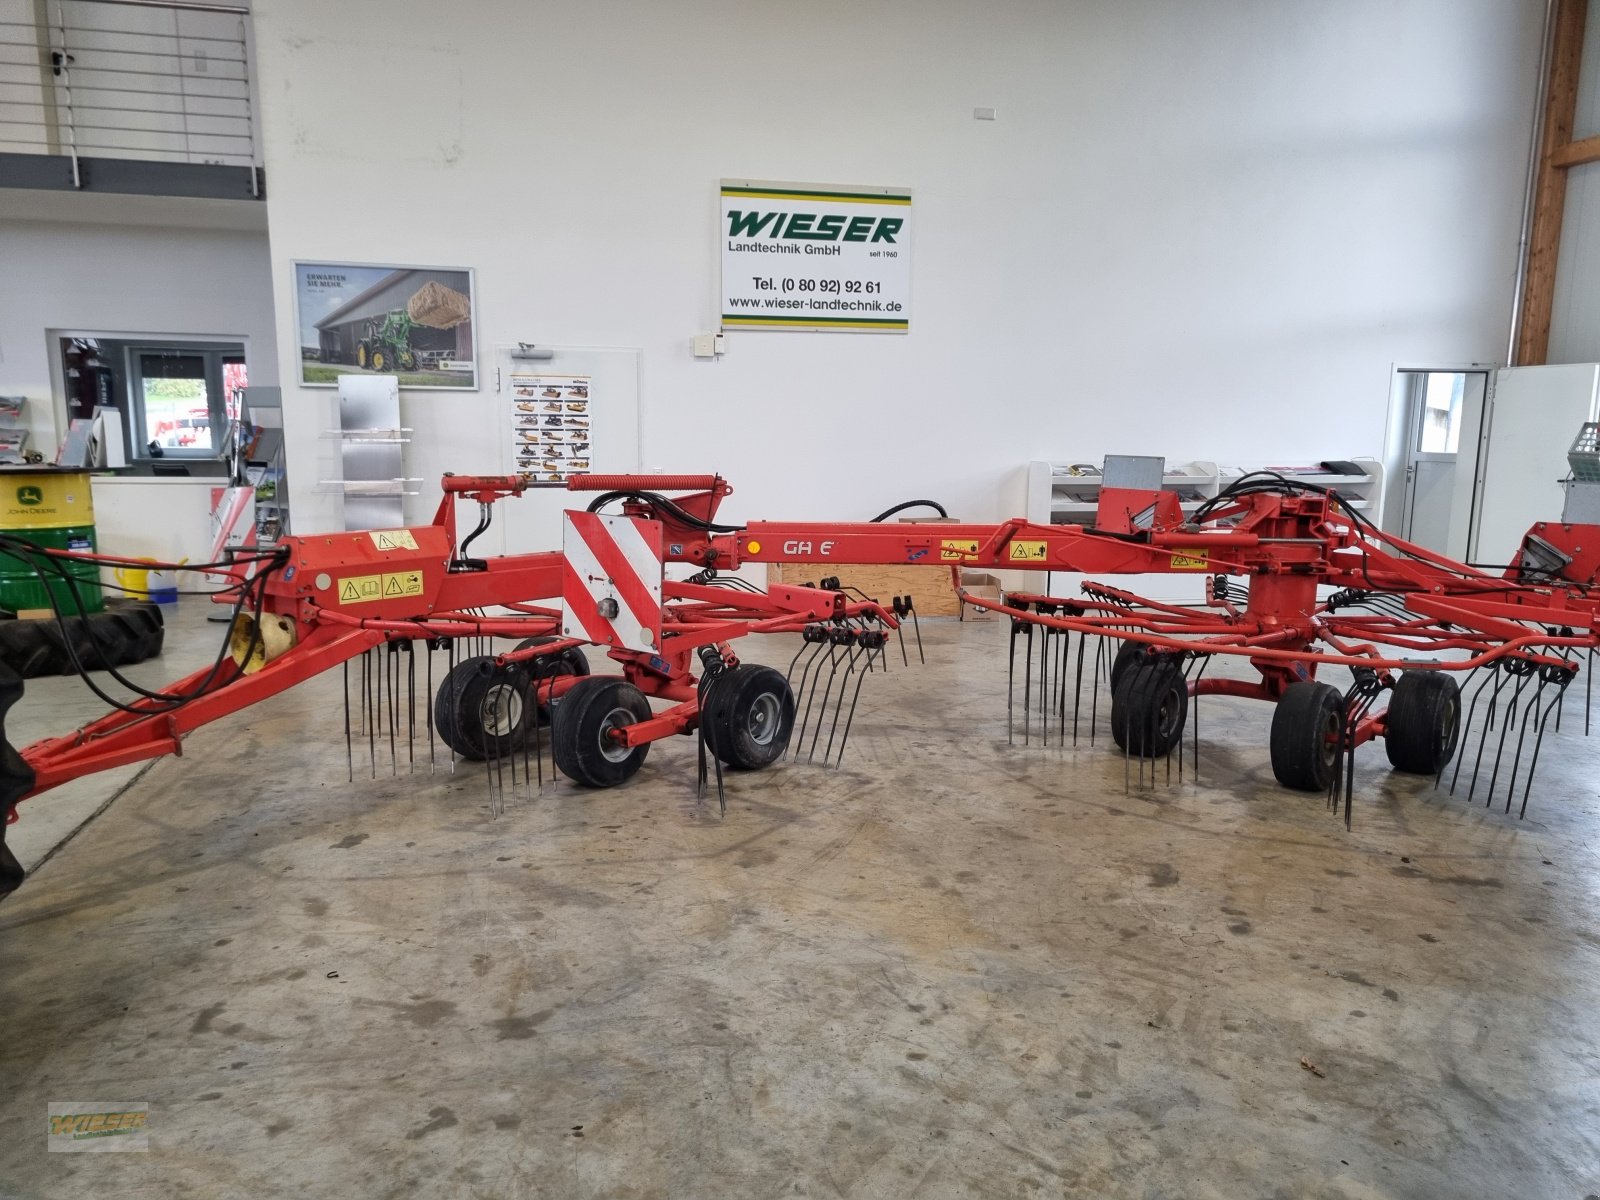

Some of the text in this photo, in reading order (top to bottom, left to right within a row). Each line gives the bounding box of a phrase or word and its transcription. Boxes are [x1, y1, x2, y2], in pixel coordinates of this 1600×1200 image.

[727, 210, 904, 243] WIESER
[728, 241, 841, 256] Landtechnik GmbH
[753, 277, 881, 295] Tel. (0 80 92) 92 61
[729, 297, 902, 312] www.wieser-landtechnik.de
[29, 507, 57, 515] DEERE
